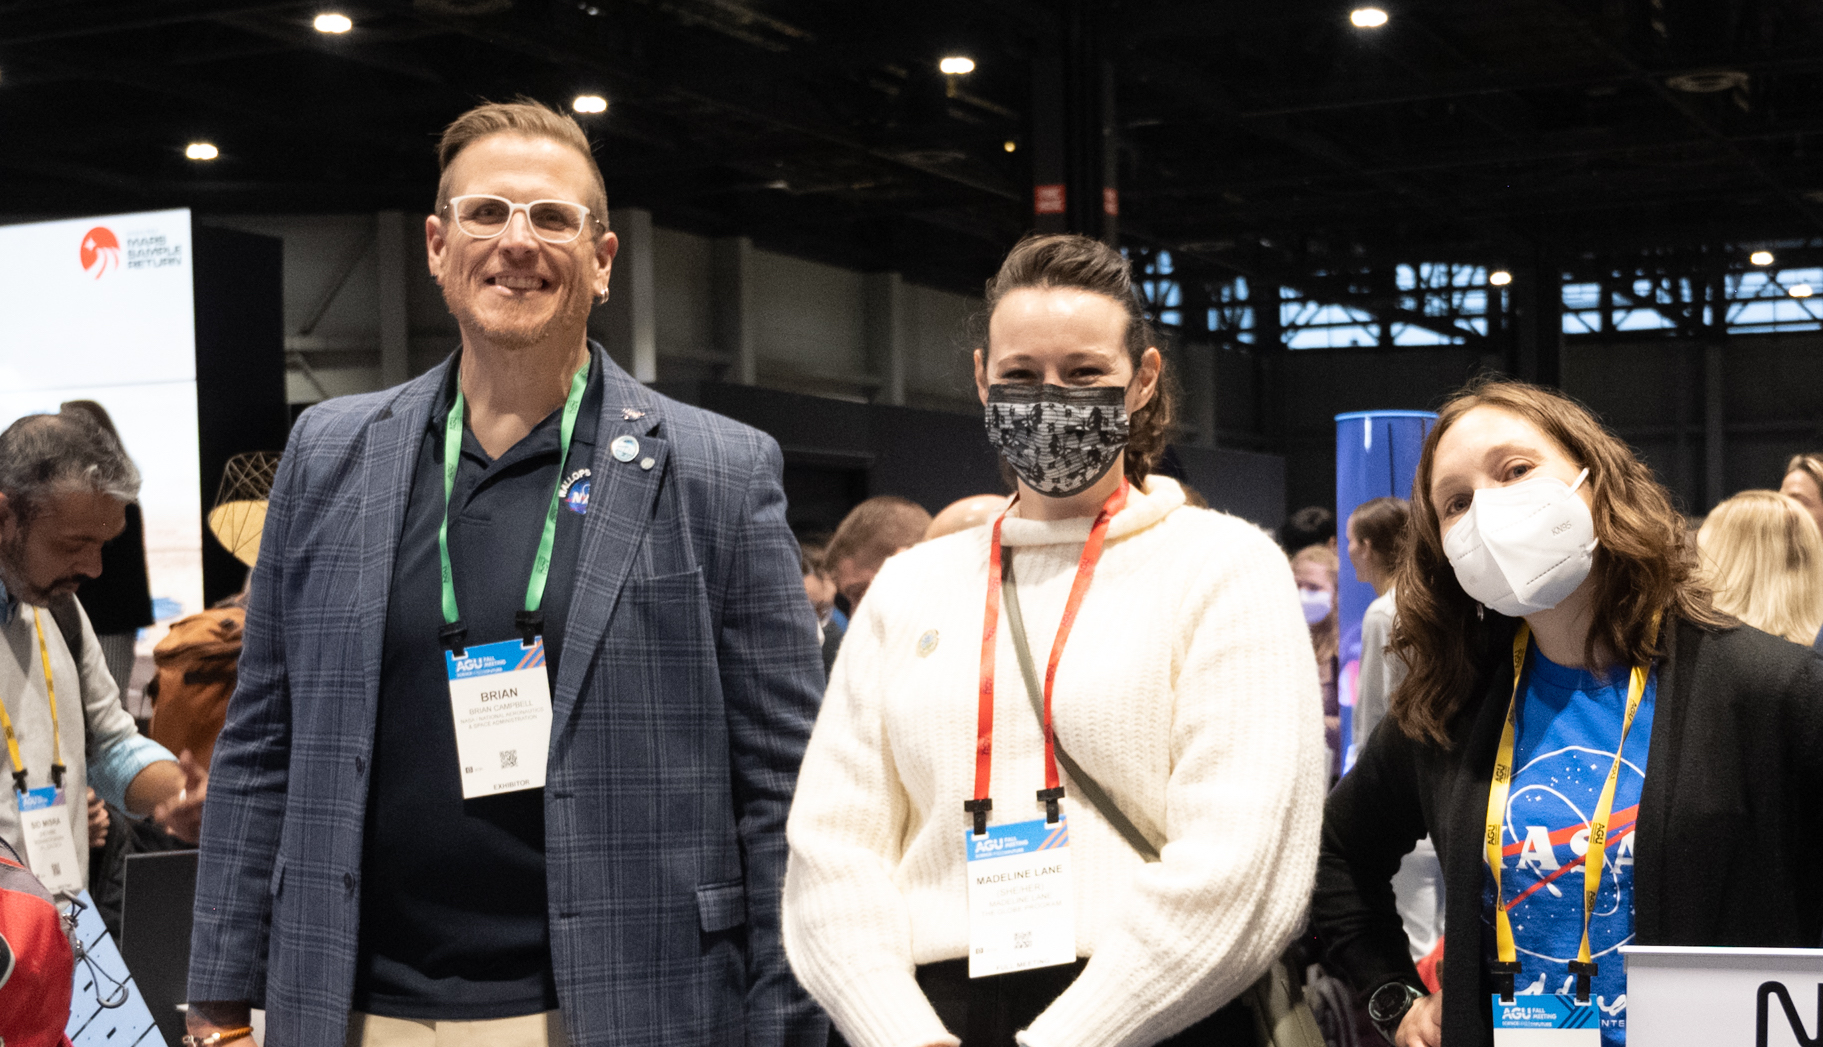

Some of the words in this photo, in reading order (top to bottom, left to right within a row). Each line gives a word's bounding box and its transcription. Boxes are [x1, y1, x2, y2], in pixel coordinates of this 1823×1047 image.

[128, 246, 181, 259] SAMPLE
[128, 258, 181, 268] RETURN
[1550, 520, 1572, 536] KN95
[456, 658, 482, 672] AGU
[481, 688, 518, 702] BRIAN
[470, 706, 492, 716] BRIAN
[494, 700, 533, 712] CAMPBELL
[494, 780, 530, 790] EXHIBITOR
[975, 838, 1003, 853] AGU
[976, 869, 1031, 885] MADELINE
[1034, 864, 1063, 876] LANE
[1502, 1008, 1531, 1020] AGU
